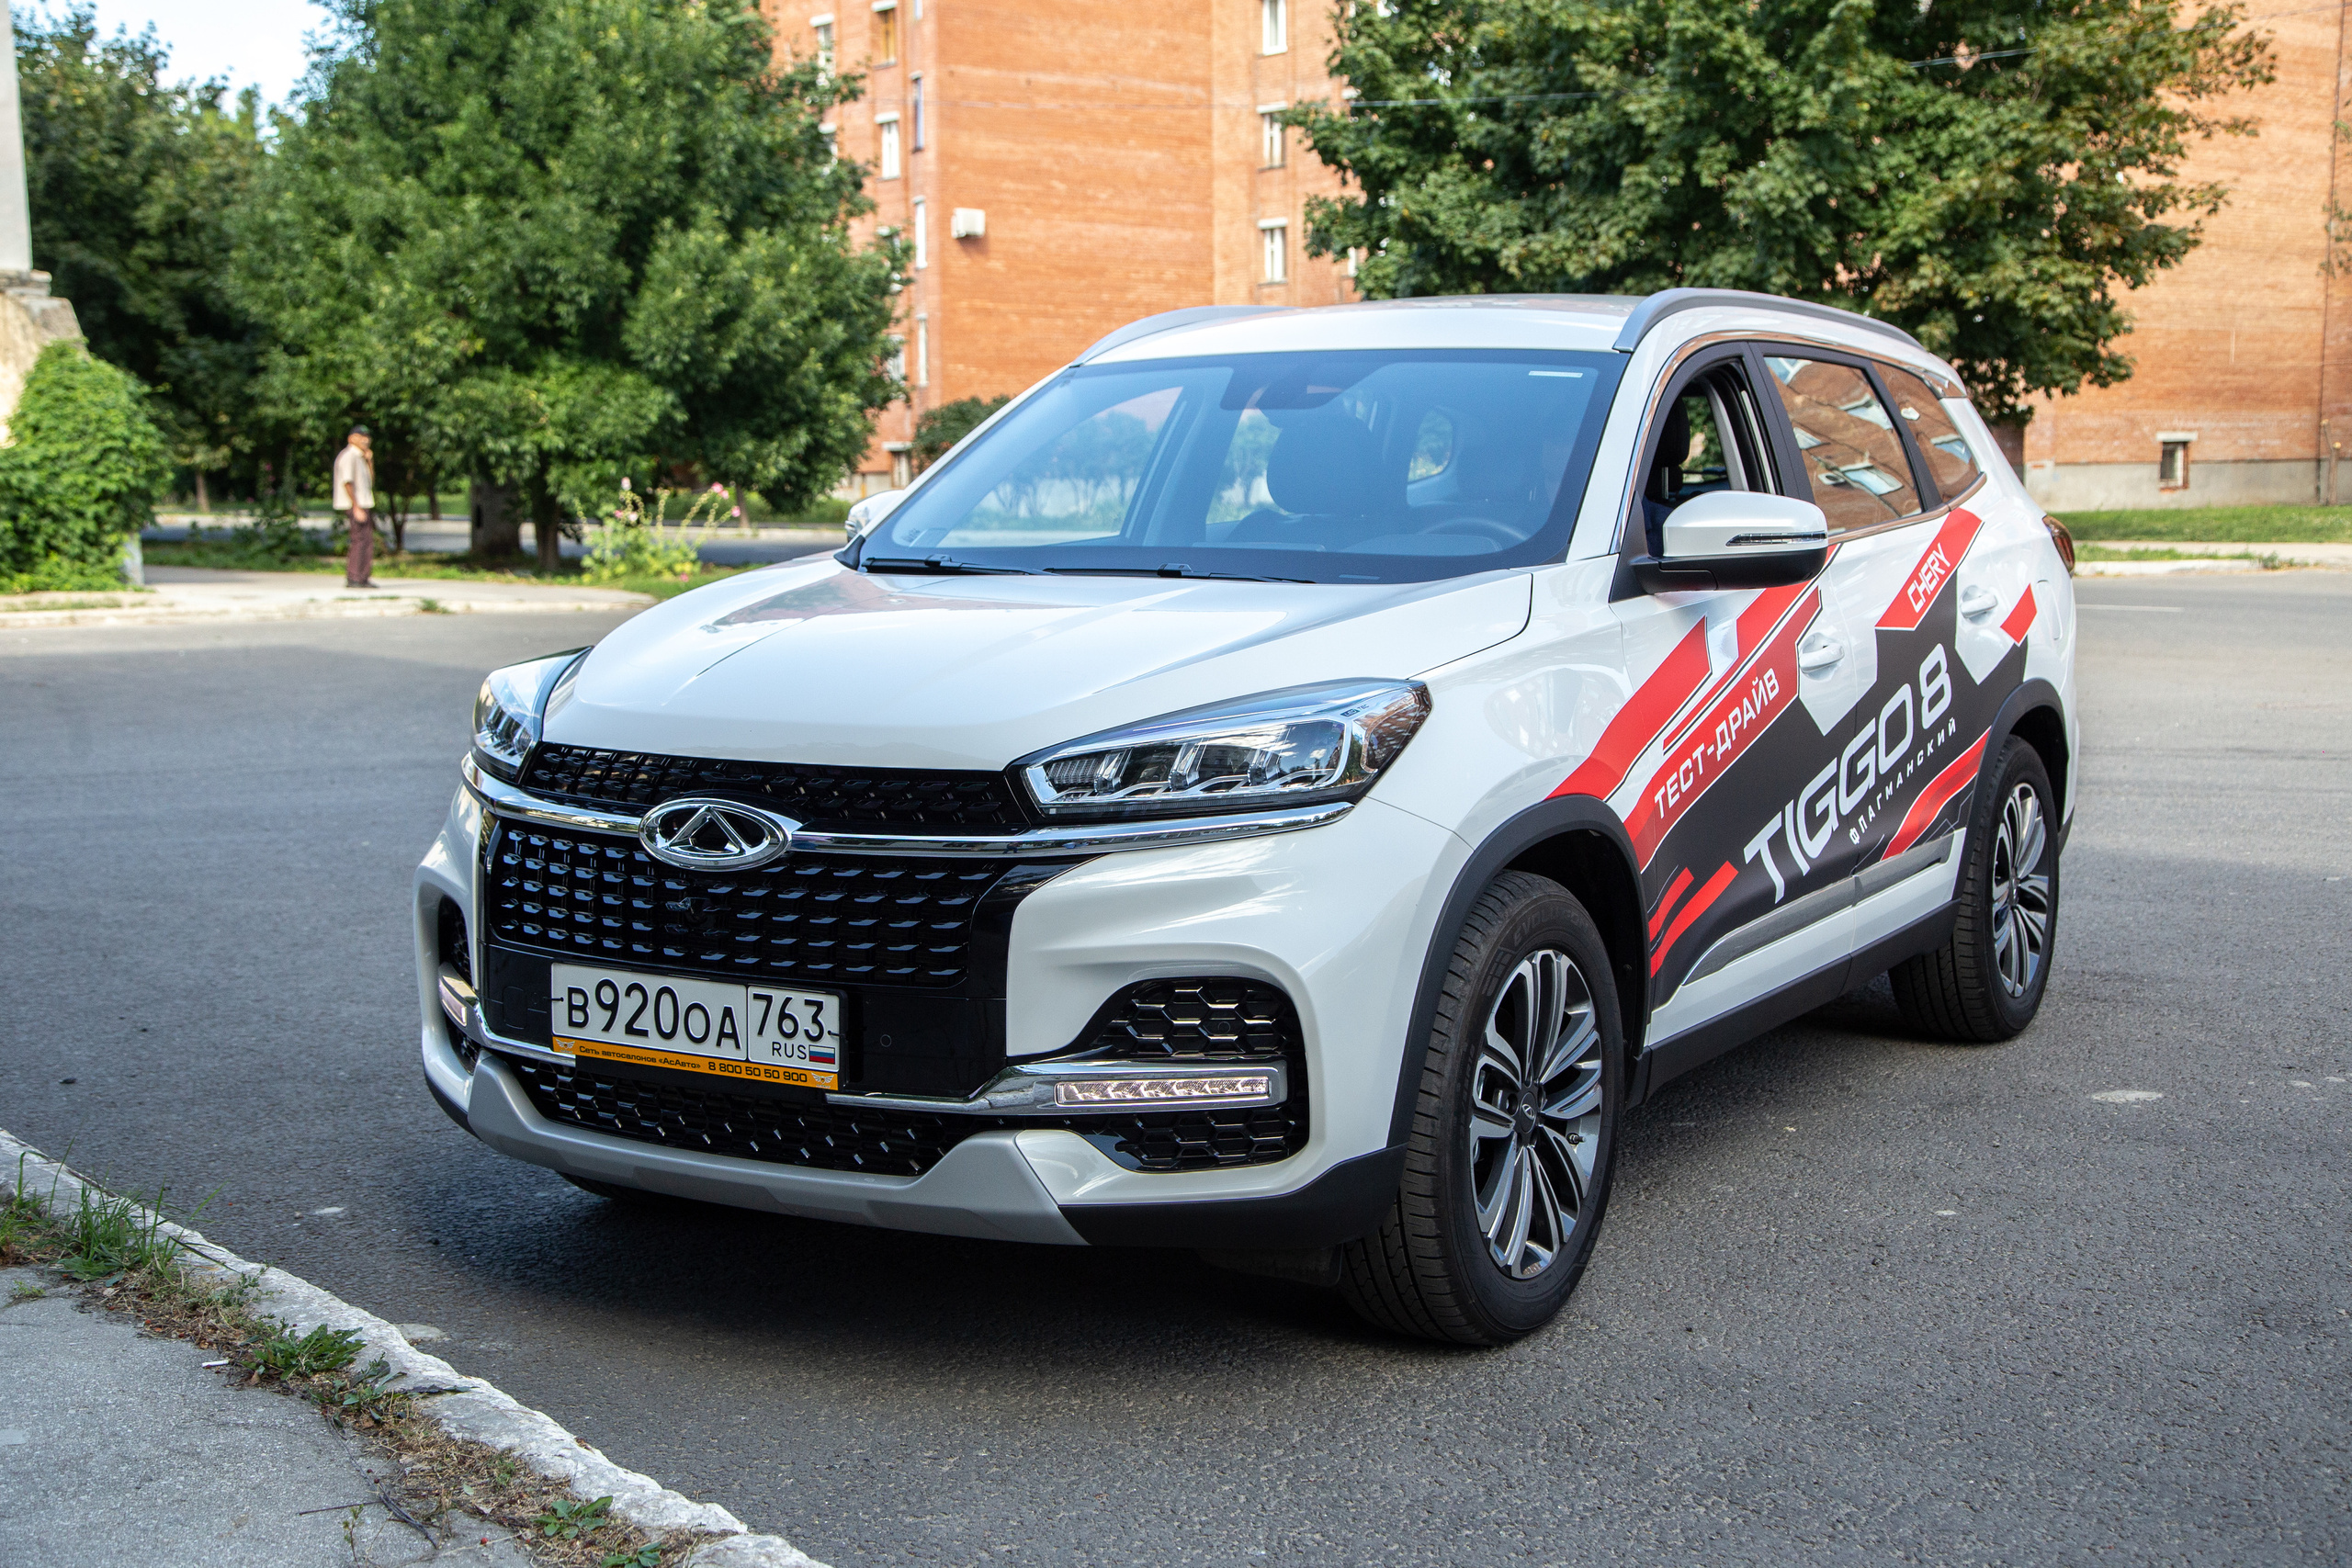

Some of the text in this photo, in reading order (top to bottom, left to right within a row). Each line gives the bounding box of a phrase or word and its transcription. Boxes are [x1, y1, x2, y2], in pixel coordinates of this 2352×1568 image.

[1906, 541, 1952, 614] CHERY
[1653, 667, 1781, 819] ТЕСТ-ДРАЙВ
[1743, 642, 1953, 904] TIGGO 8
[1849, 716, 1957, 845] ФЛАГМАНСКИЙ
[752, 993, 825, 1042] 763
[772, 1041, 807, 1060] RUS
[579, 1045, 600, 1055] Сеть
[602, 1050, 657, 1064] автосалонов
[708, 1061, 716, 1071] 8
[719, 1063, 742, 1075] 800
[745, 1066, 761, 1077] 50
[764, 1068, 780, 1079] 50
[783, 1071, 808, 1083] 900
